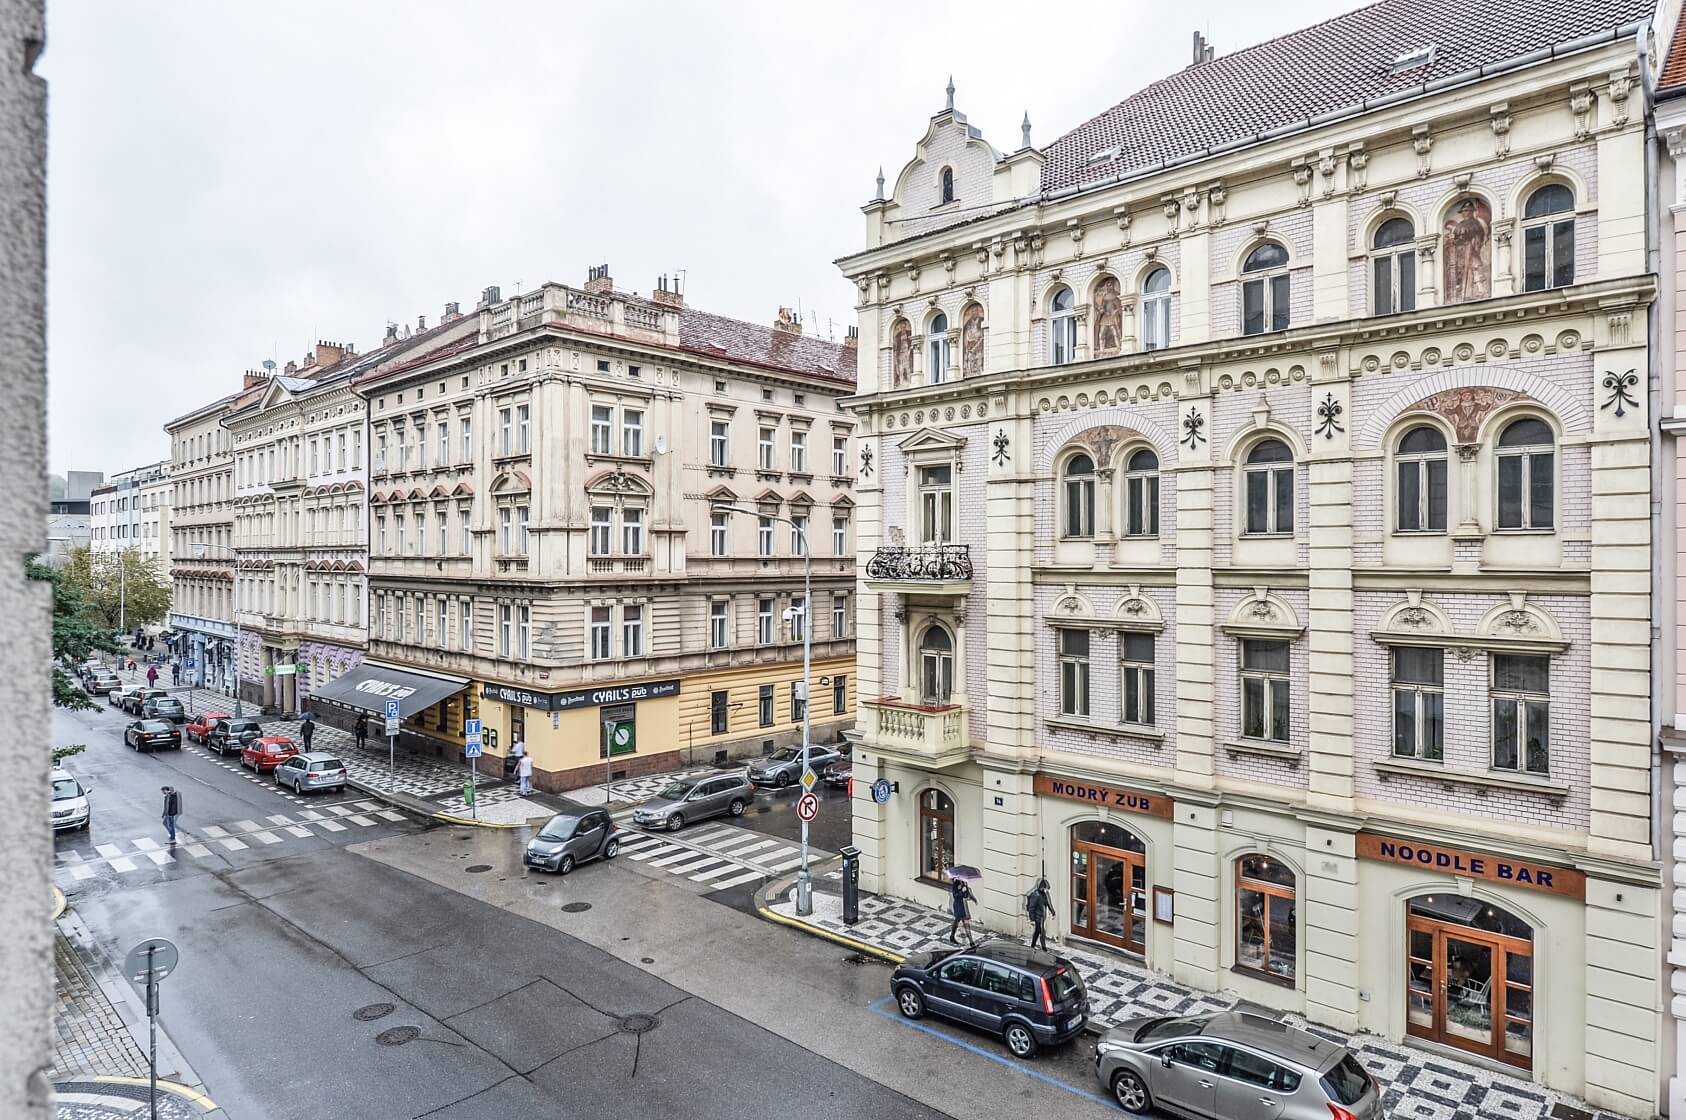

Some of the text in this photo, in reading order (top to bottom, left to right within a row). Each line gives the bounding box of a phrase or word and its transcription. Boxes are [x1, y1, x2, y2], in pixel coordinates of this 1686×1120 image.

[592, 688, 629, 703] CYRIL'S
[632, 687, 647, 698] pub
[1053, 782, 1150, 810] MODRÝ ZUB
[1381, 842, 1553, 887] NOODLE BAR
